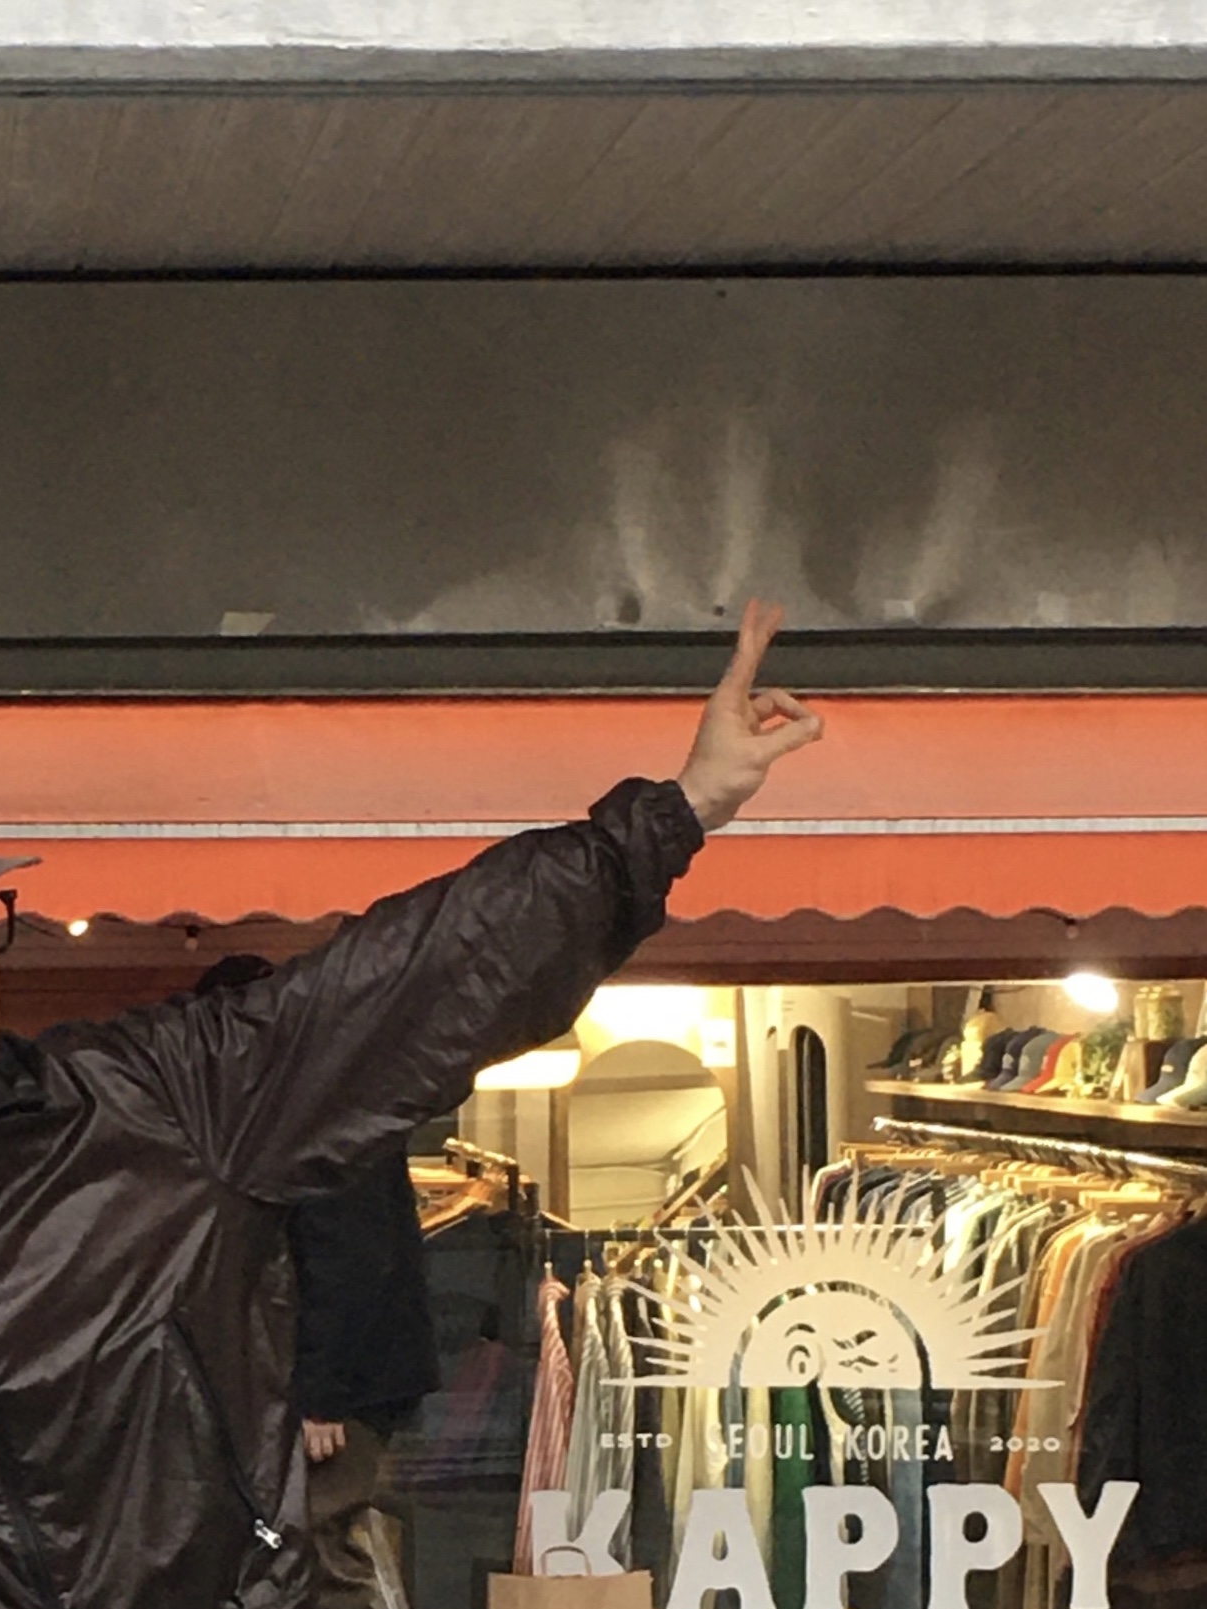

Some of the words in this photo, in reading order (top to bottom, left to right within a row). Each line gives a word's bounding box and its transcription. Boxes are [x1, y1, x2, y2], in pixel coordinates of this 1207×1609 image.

[600, 1432, 673, 1449] ESTD
[706, 1422, 815, 1461] SEOUL
[844, 1421, 954, 1462] KOREA
[990, 1434, 1061, 1453] 2020
